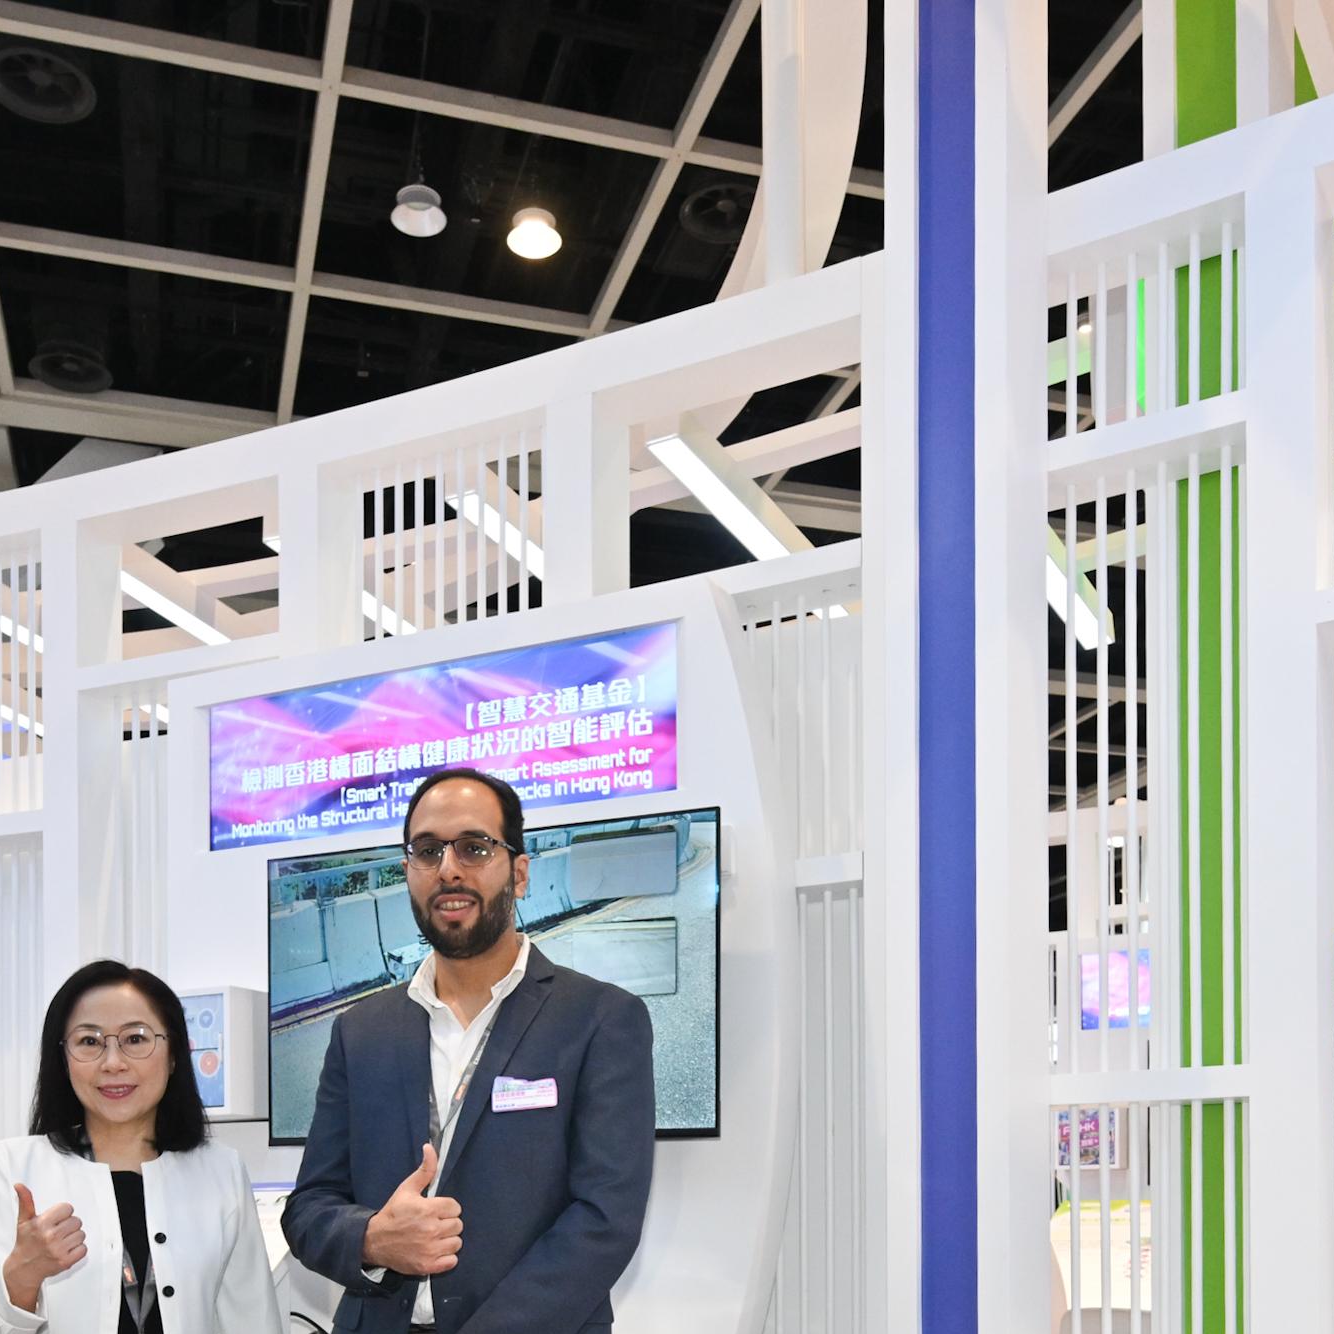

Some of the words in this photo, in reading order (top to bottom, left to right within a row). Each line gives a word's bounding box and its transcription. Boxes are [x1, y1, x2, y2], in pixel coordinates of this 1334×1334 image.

[465, 675, 646, 729] 【智慧交通基金】
[241, 709, 653, 793] 檢測香港橋面結構健康狀況的智能評估
[532, 748, 626, 779] Assessment
[629, 746, 654, 765] for
[232, 817, 295, 839] Monitoring
[297, 813, 318, 830] the
[321, 802, 389, 827] Structural
[554, 778, 568, 796] in
[571, 775, 610, 795] Hong
[613, 769, 653, 789] Kong
